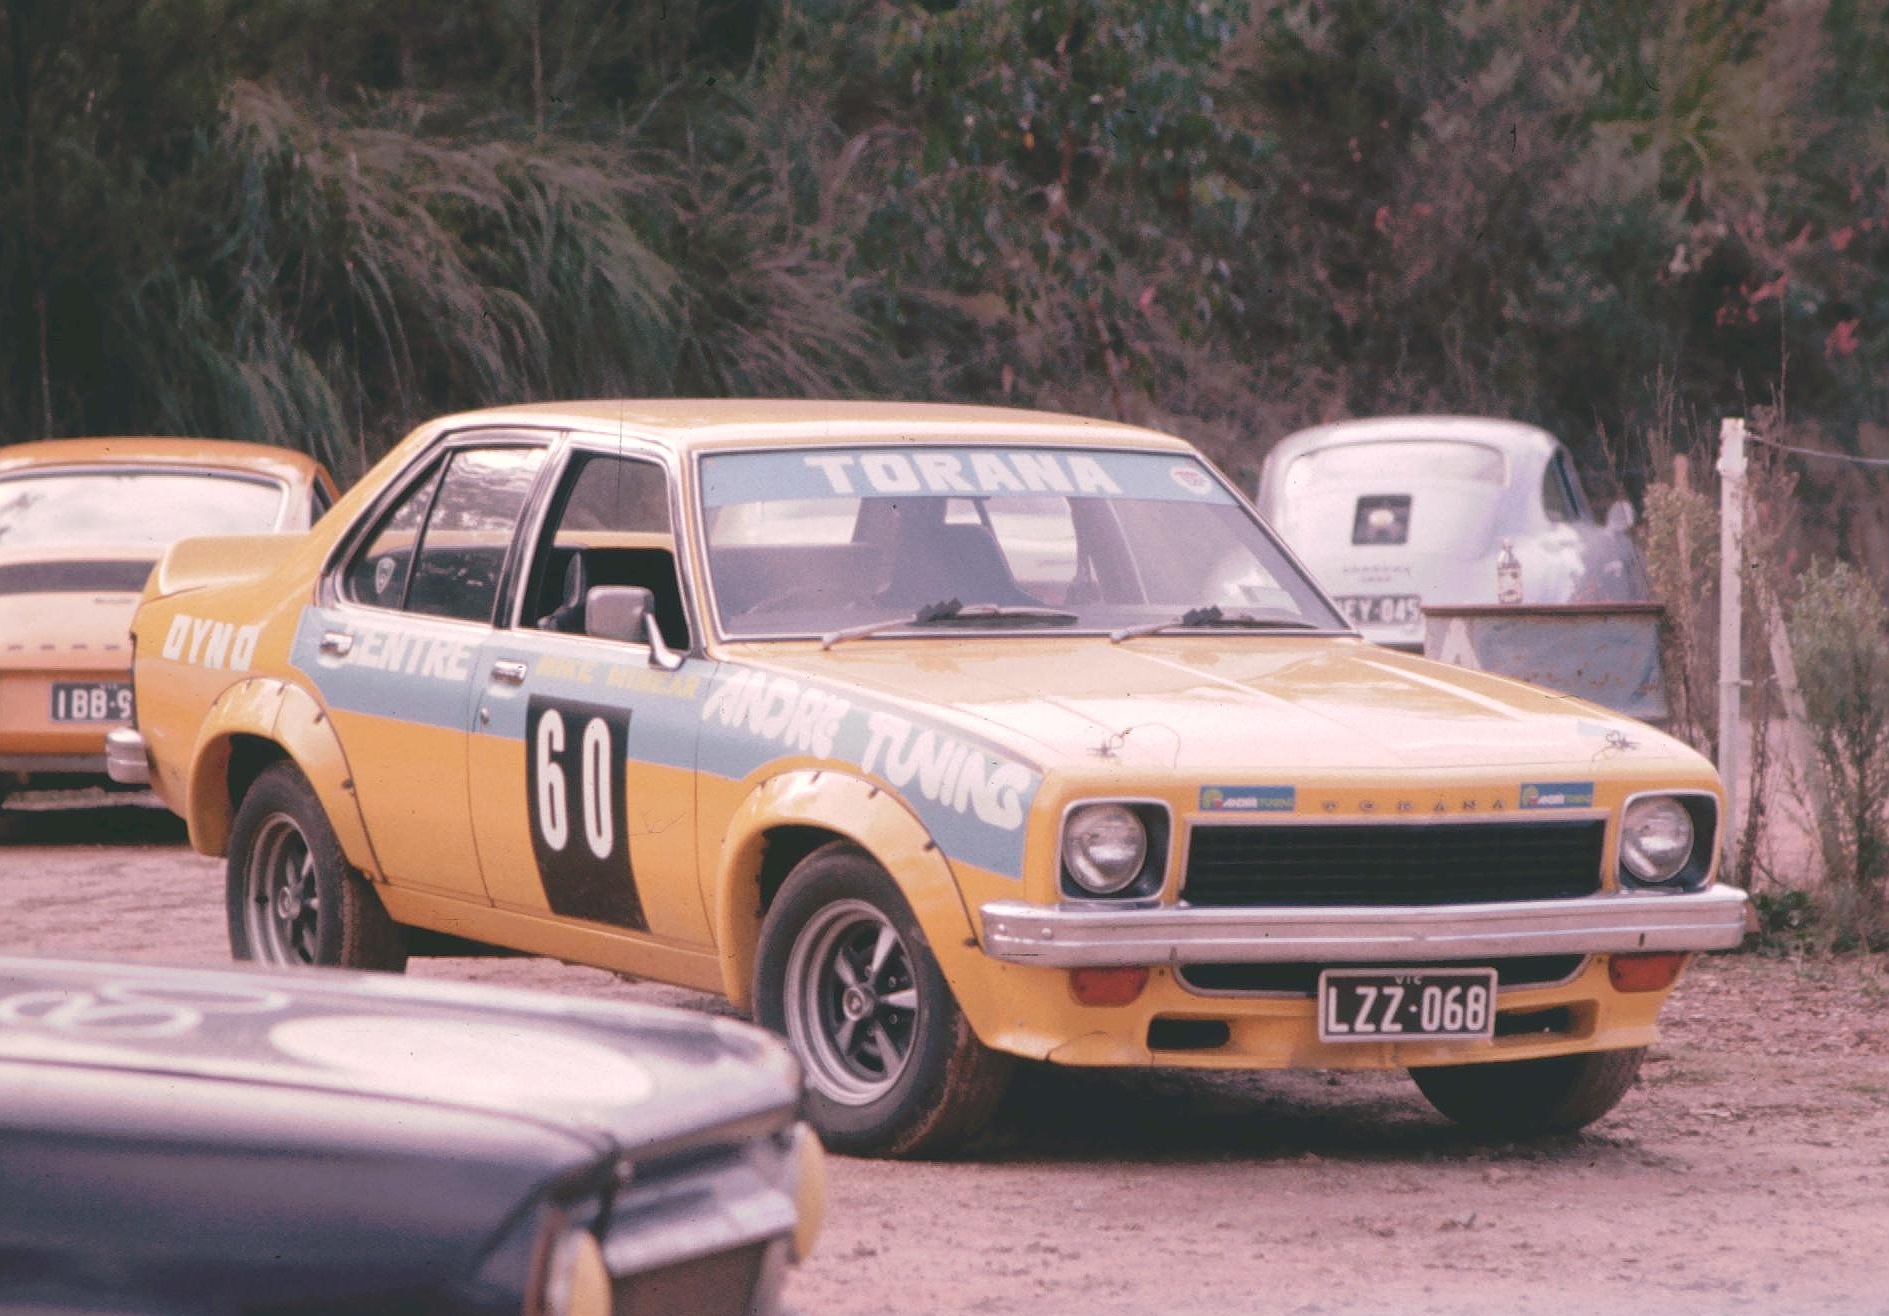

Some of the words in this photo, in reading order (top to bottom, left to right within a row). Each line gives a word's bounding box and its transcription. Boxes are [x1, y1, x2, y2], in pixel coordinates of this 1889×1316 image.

[804, 453, 1123, 494] TORANA
[162, 614, 261, 673] DYNO
[702, 668, 850, 761] ANDRE
[537, 708, 613, 861] 60
[861, 711, 1033, 831] TUNING
